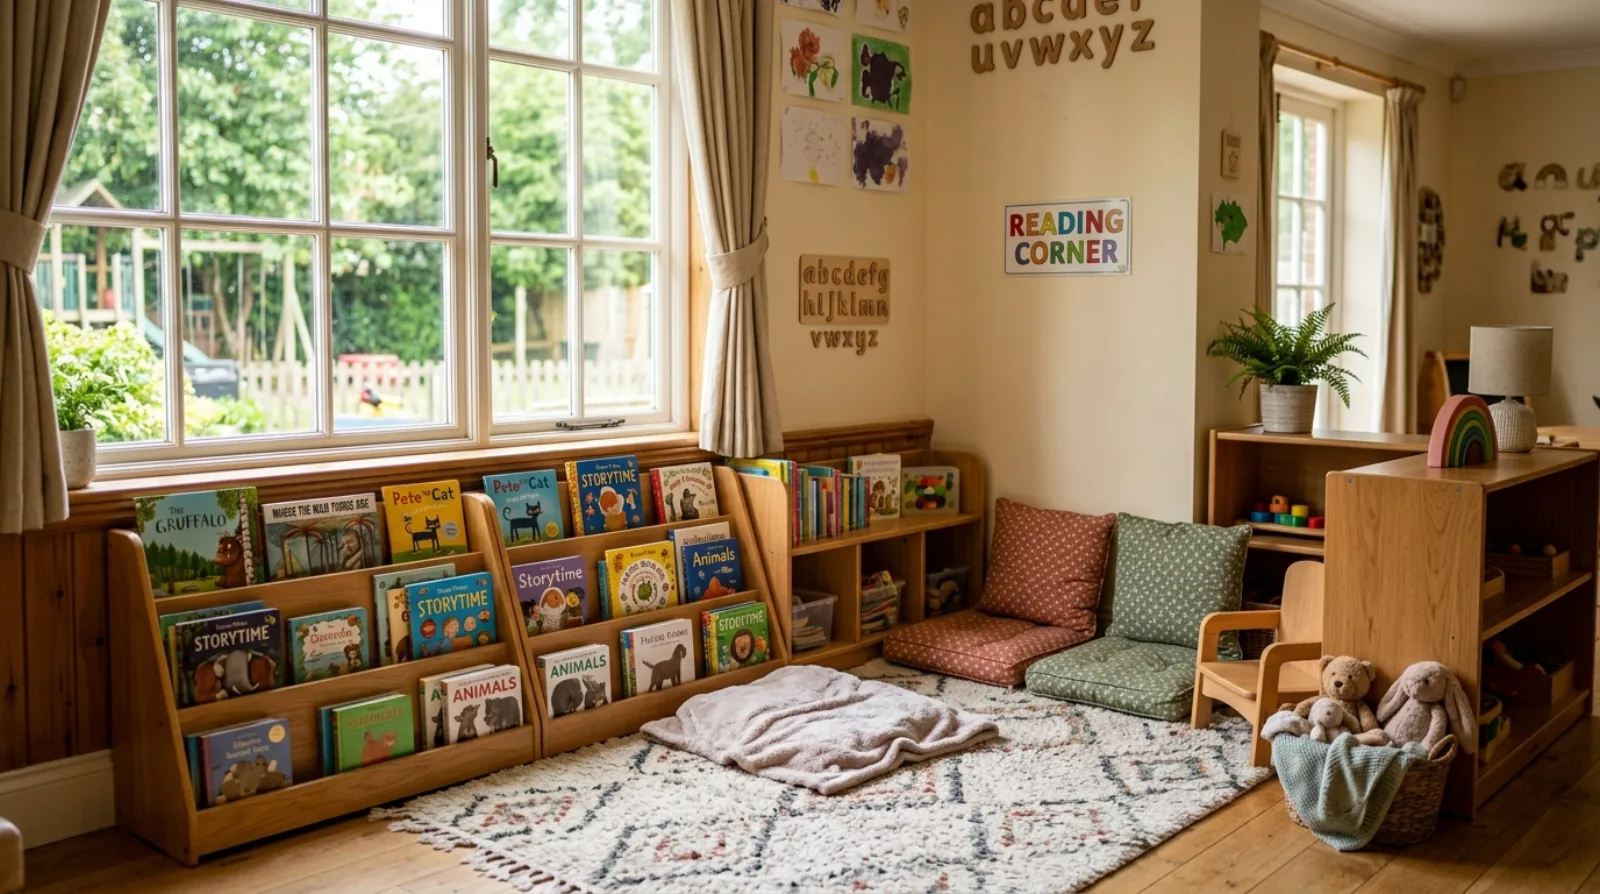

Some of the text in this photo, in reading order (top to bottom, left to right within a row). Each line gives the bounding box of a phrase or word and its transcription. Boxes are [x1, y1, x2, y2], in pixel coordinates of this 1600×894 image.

[970, 19, 1156, 74] uvwxyz
[1010, 208, 1124, 237] READING
[1015, 239, 1119, 266] CORNER
[803, 258, 889, 294] abcdefg
[810, 330, 879, 356] vwxyz
[528, 475, 550, 489] Cat
[392, 491, 422, 506] Pete
[432, 486, 455, 501] Cat
[155, 513, 227, 534] GRUFFALO
[168, 506, 184, 515] THE
[692, 546, 736, 567] Animals
[519, 566, 583, 588] Storytime
[417, 589, 488, 617] STORYTIME
[194, 624, 270, 652] STORYTIME
[550, 654, 607, 678] ANIMALS
[453, 676, 517, 703] ANIMALS
